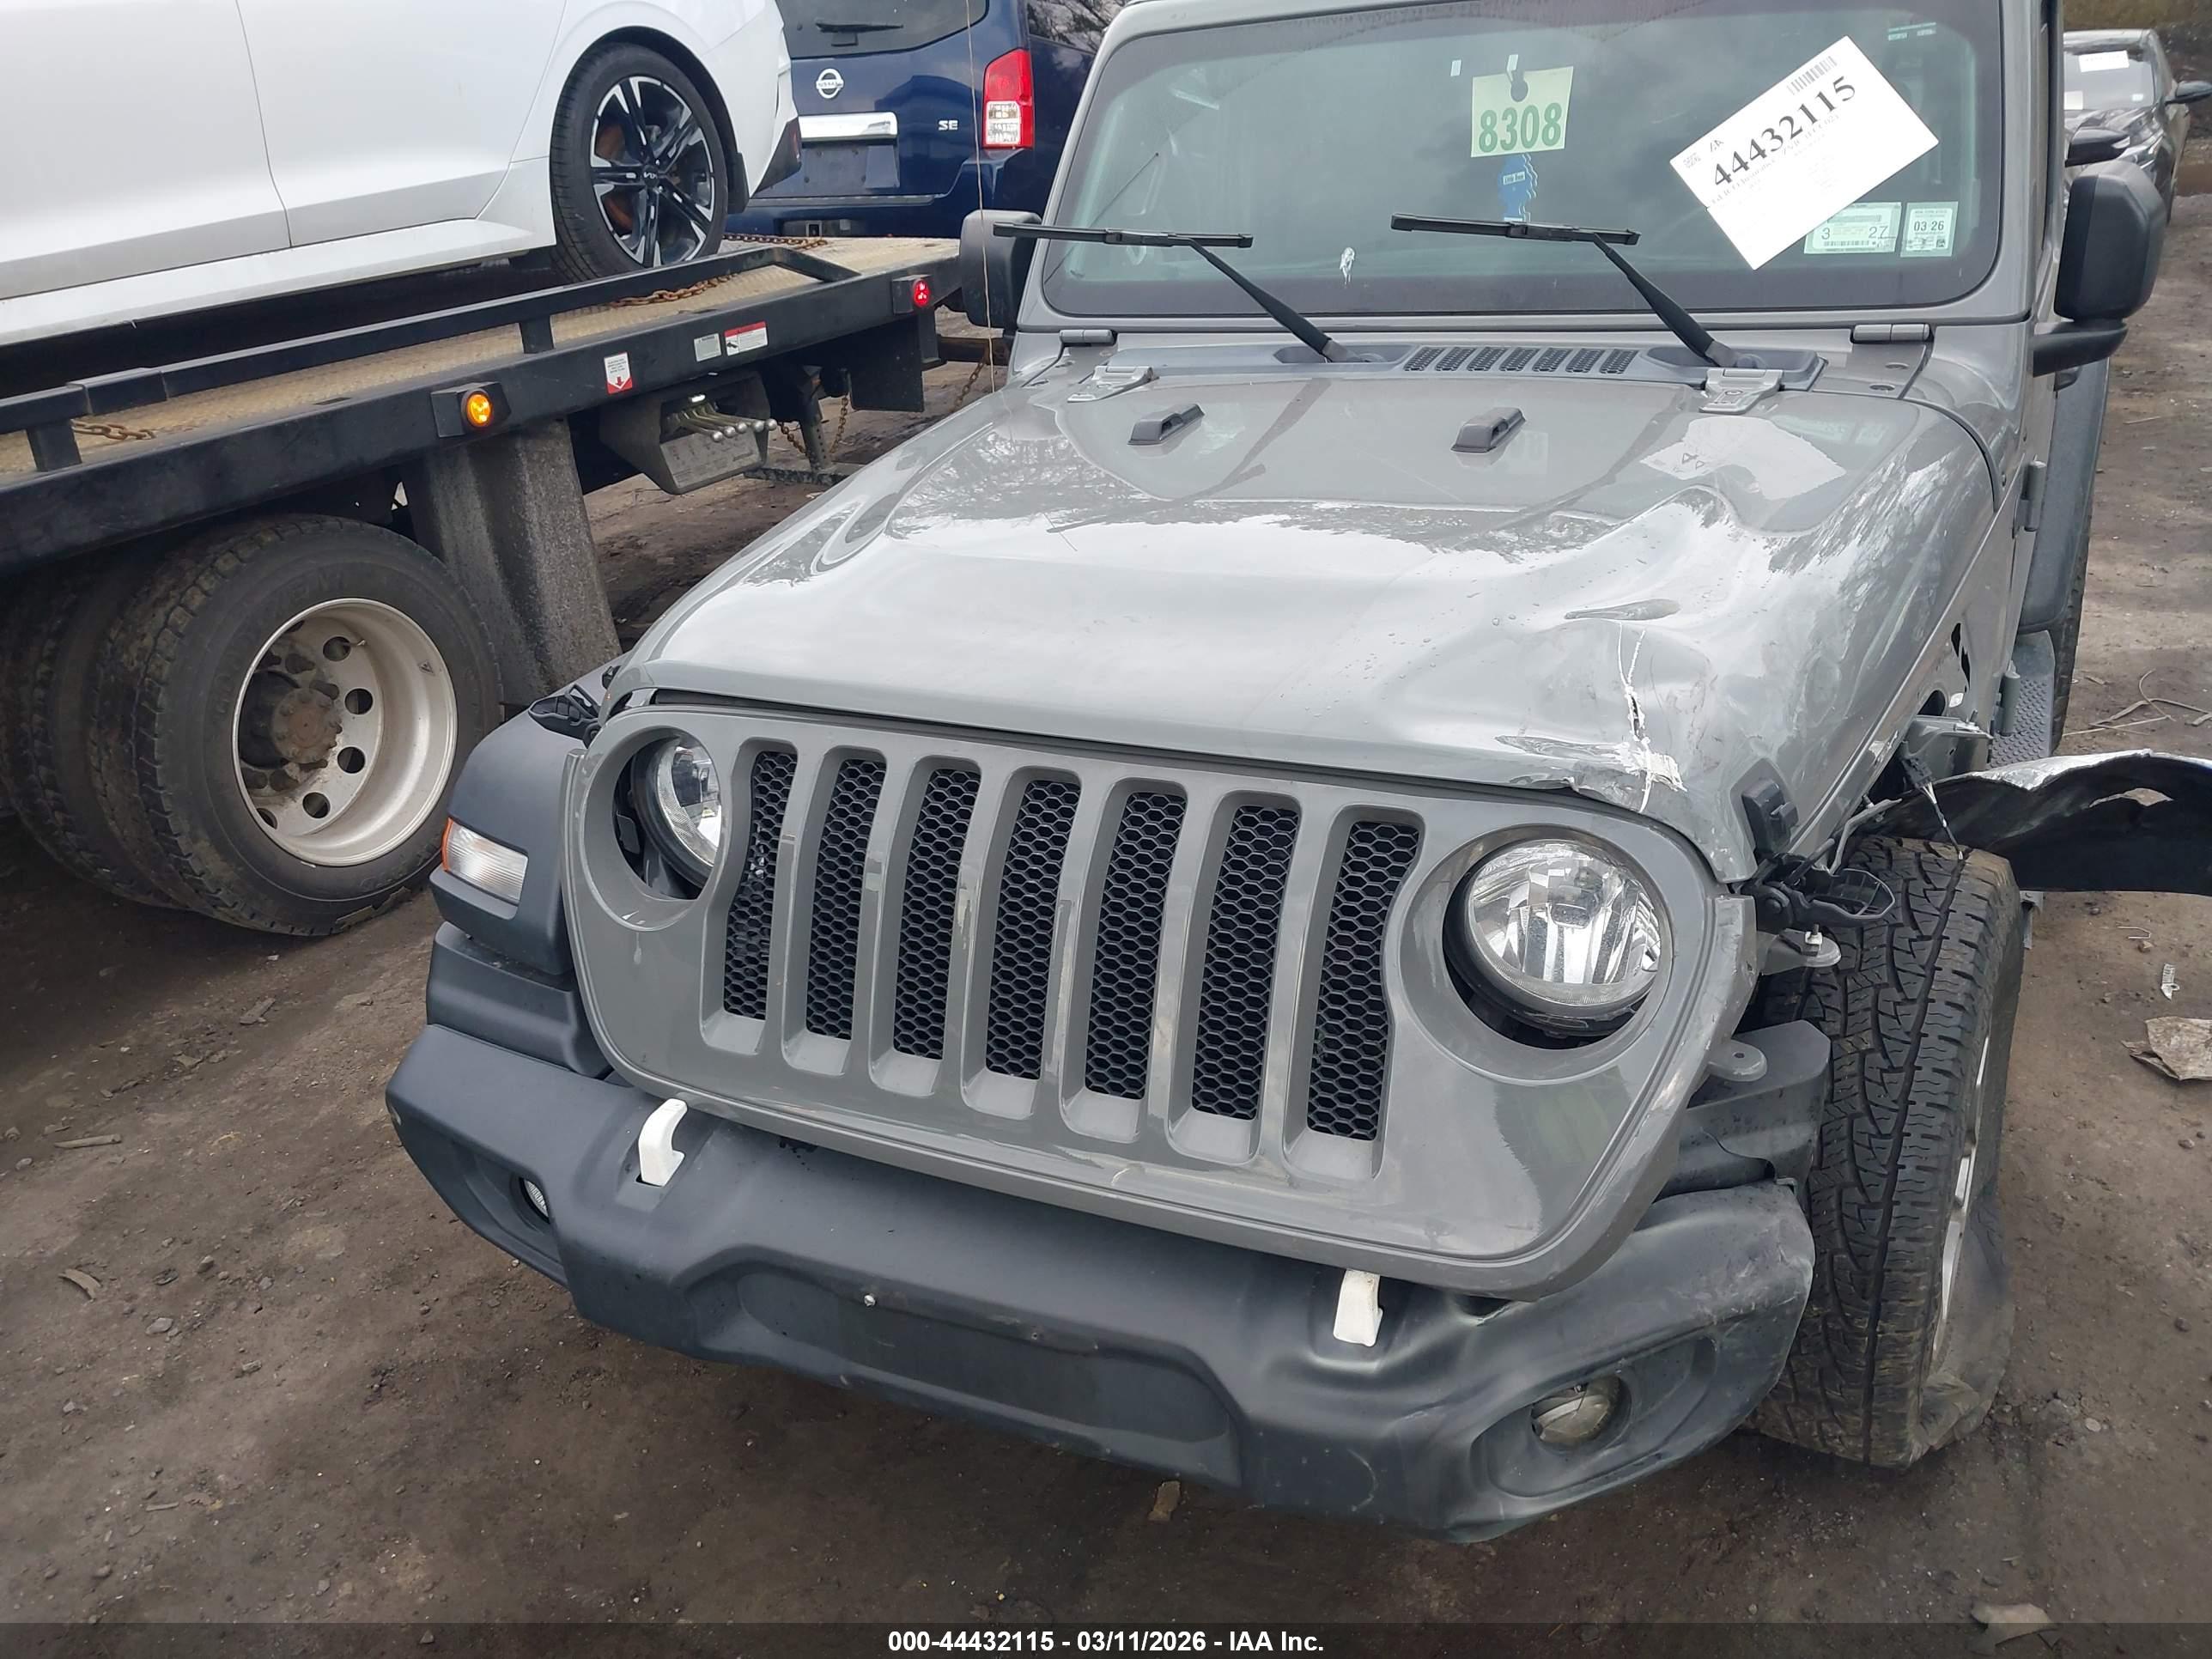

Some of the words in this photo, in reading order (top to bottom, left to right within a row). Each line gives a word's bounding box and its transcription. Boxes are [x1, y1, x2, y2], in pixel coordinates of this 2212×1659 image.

[938, 118, 958, 131] SE
[1478, 101, 1563, 153] 8308
[1712, 76, 1856, 186] 44432115
[1913, 221, 1927, 231] 03
[1930, 220, 1944, 231] 26
[1821, 227, 1831, 240] 3
[1868, 226, 1888, 239] 27
